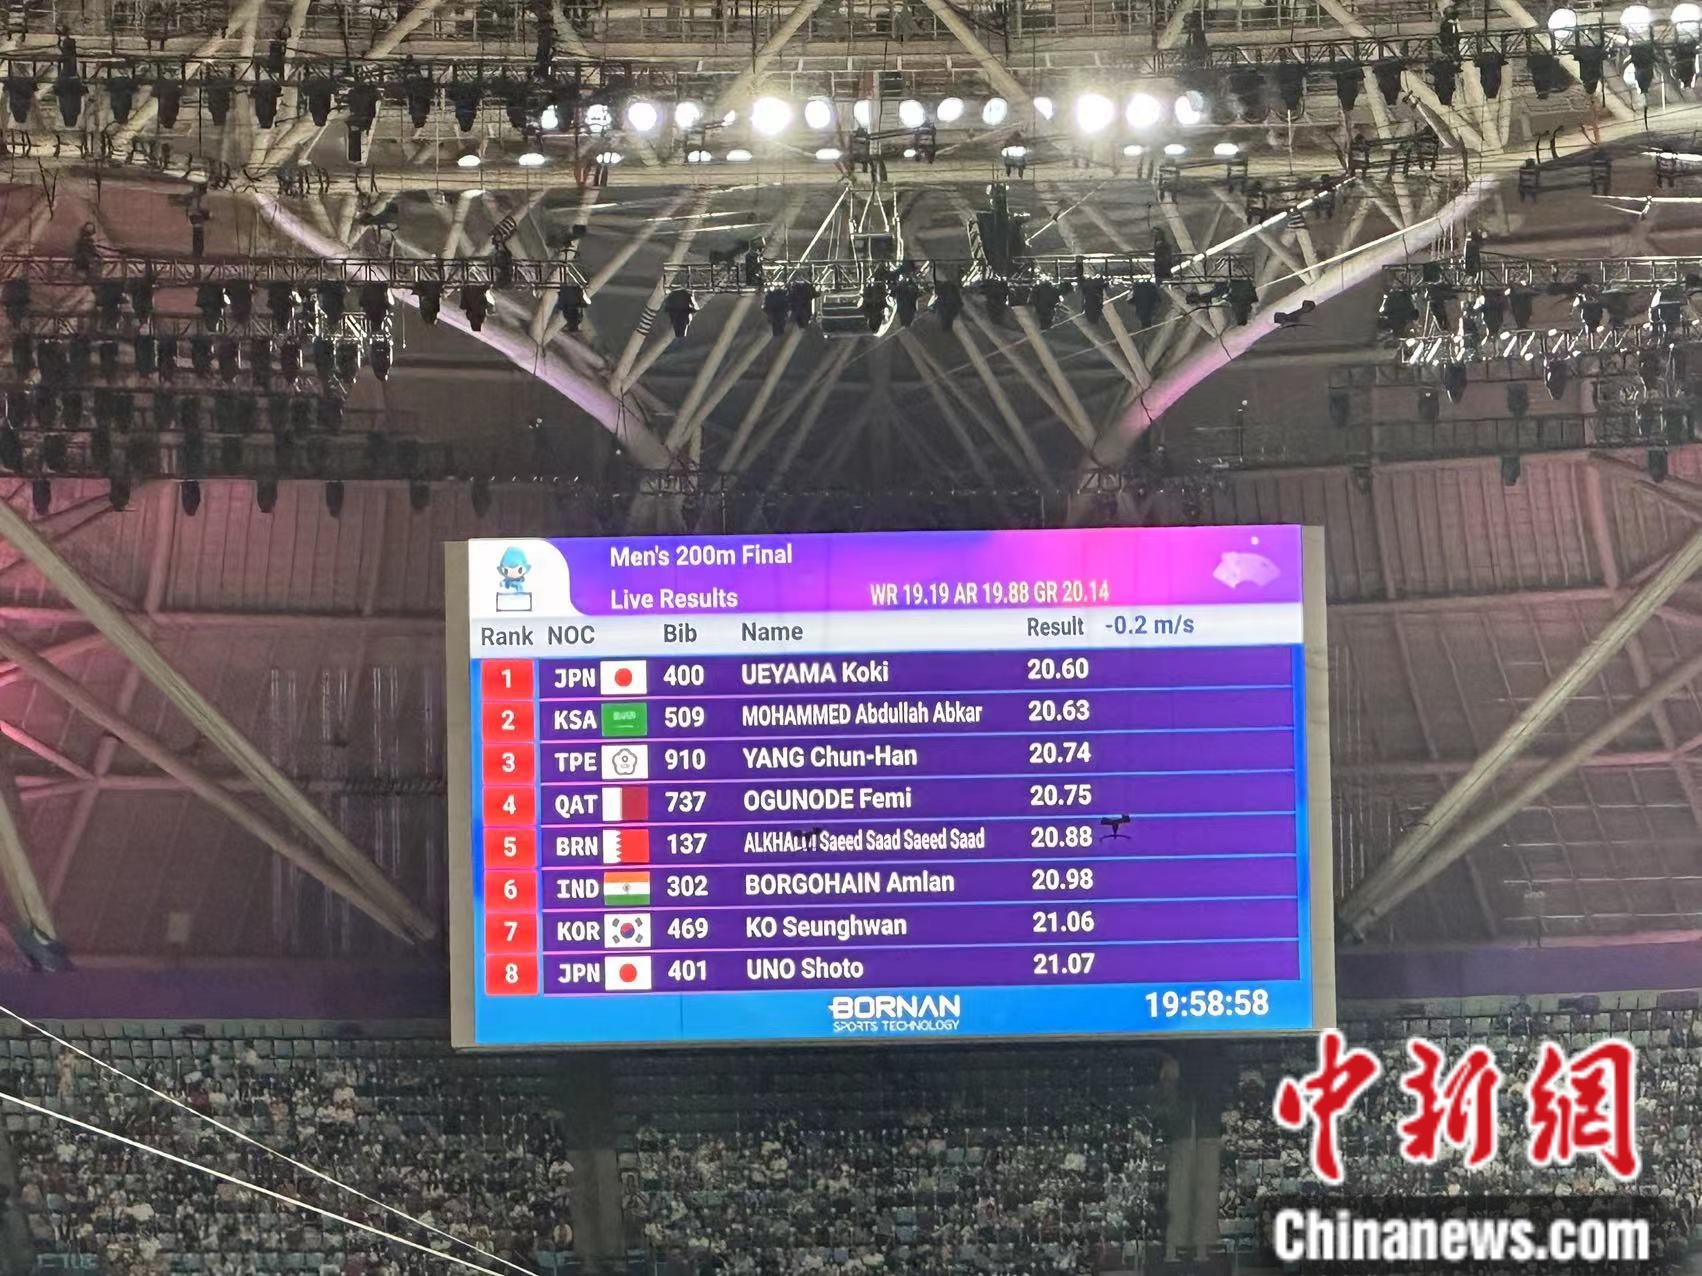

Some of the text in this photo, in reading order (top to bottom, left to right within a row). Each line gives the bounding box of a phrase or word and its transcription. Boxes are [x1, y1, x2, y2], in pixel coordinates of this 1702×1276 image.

[610, 543, 793, 567] Men's 200m Final
[611, 587, 738, 609] Live Results
[870, 580, 1109, 605] WR 19.19 AR 19.88 GR 20.14
[481, 614, 1194, 645] Rank NOC Bib Name Result -0.2 m/s
[501, 658, 1089, 688] 1 JPN 400 UEYAMA Koki 20.60
[501, 710, 515, 730] 2
[554, 710, 597, 730] KSA
[664, 707, 705, 728] 509
[742, 704, 851, 726] MOHAMMED
[855, 702, 928, 724] Abdullah
[932, 701, 983, 723] Abkar
[1028, 699, 1090, 721] 20.63
[502, 741, 1091, 772] 3 TPE 910 YANG Chun-Han 20.74
[503, 784, 1092, 818] 4 QAT 737 OGUNODE Femi 20.75
[503, 837, 517, 857] 5
[556, 837, 598, 857] BRN
[666, 833, 708, 854] 137
[819, 829, 863, 851] Saeed
[866, 828, 901, 850] Saad
[903, 828, 947, 850] Saeed
[950, 827, 985, 849] Saad
[1031, 826, 1093, 848] 20.88
[504, 869, 1094, 899] 6 IND 302 BORGOHAIN Amlan 20.98
[504, 911, 1095, 941] 7 KOR 469 KO Seunghwan 21.06
[504, 953, 1096, 984] 8 JPN 401 UNO Shoto 21.07
[828, 994, 961, 1019] BORNAN
[1145, 989, 1270, 1018] 19:58:58
[832, 1019, 960, 1032] SPORTS TECHNOLOGY
